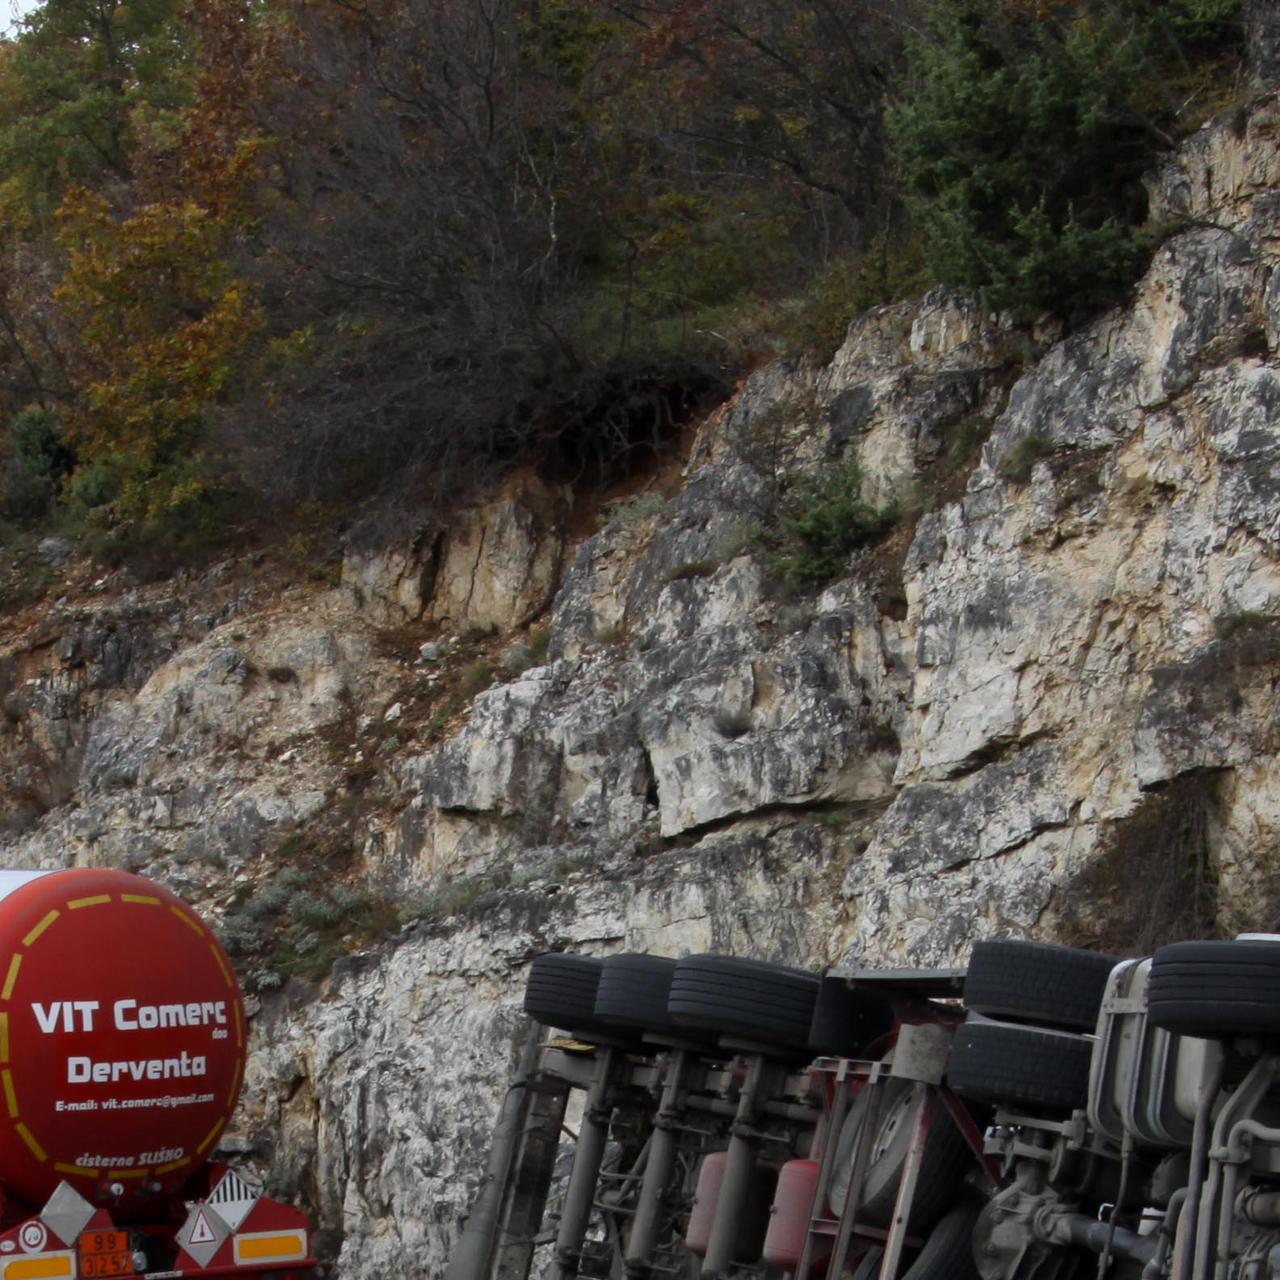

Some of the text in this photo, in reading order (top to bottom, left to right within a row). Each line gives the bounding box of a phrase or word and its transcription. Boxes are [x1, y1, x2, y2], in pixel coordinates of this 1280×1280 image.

[32, 999, 227, 1033] VIT Comerc
[67, 1051, 206, 1083] Derventa
[55, 1100, 98, 1111] E-mail:
[75, 1153, 135, 1167] cisterne
